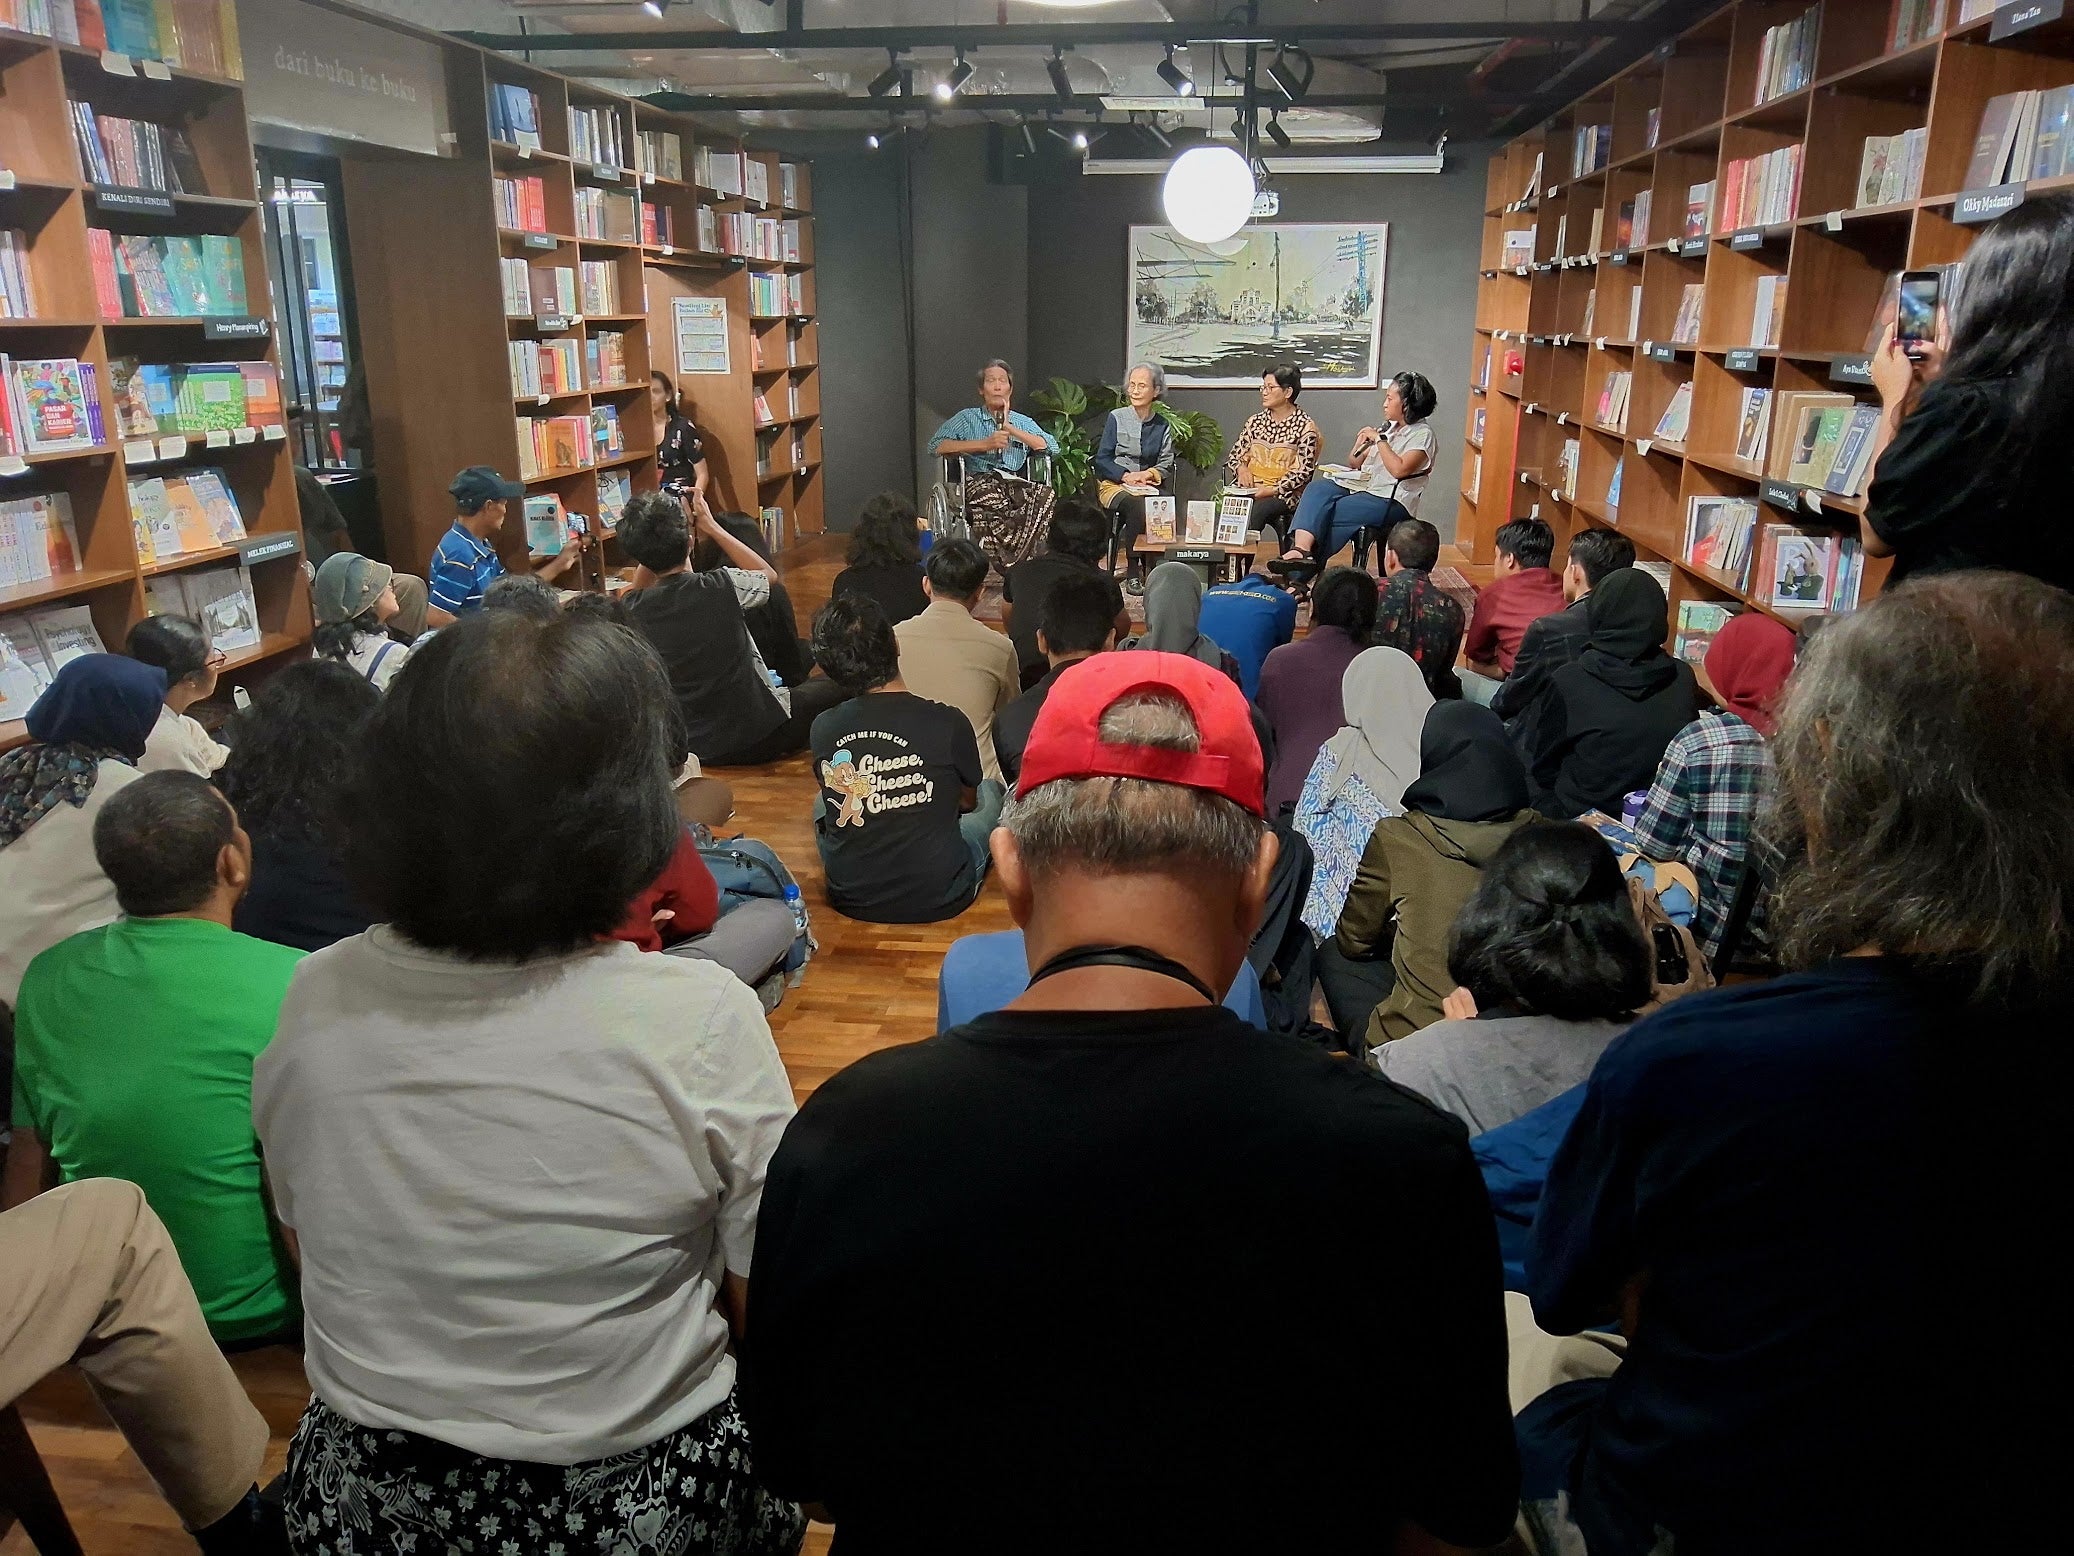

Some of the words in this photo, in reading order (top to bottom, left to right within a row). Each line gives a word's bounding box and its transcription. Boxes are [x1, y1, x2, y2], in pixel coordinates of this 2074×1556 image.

[274, 45, 309, 75] dari
[314, 55, 356, 87] buku
[381, 73, 417, 102] buku
[101, 192, 128, 202] KENALI
[1963, 197, 1981, 213] Okky
[1981, 192, 2015, 212] Madasari
[44, 405, 67, 413] PASAR
[1176, 550, 1210, 559] makarya
[57, 636, 97, 651] Investing
[836, 733, 856, 748] CATCH
[857, 731, 868, 739] ME
[870, 730, 877, 738] IF
[878, 732, 893, 741] YOU
[893, 736, 909, 748] CAN
[858, 754, 924, 776] Cheese,
[867, 772, 927, 794] Cheese,
[866, 781, 934, 814] Cheese!
